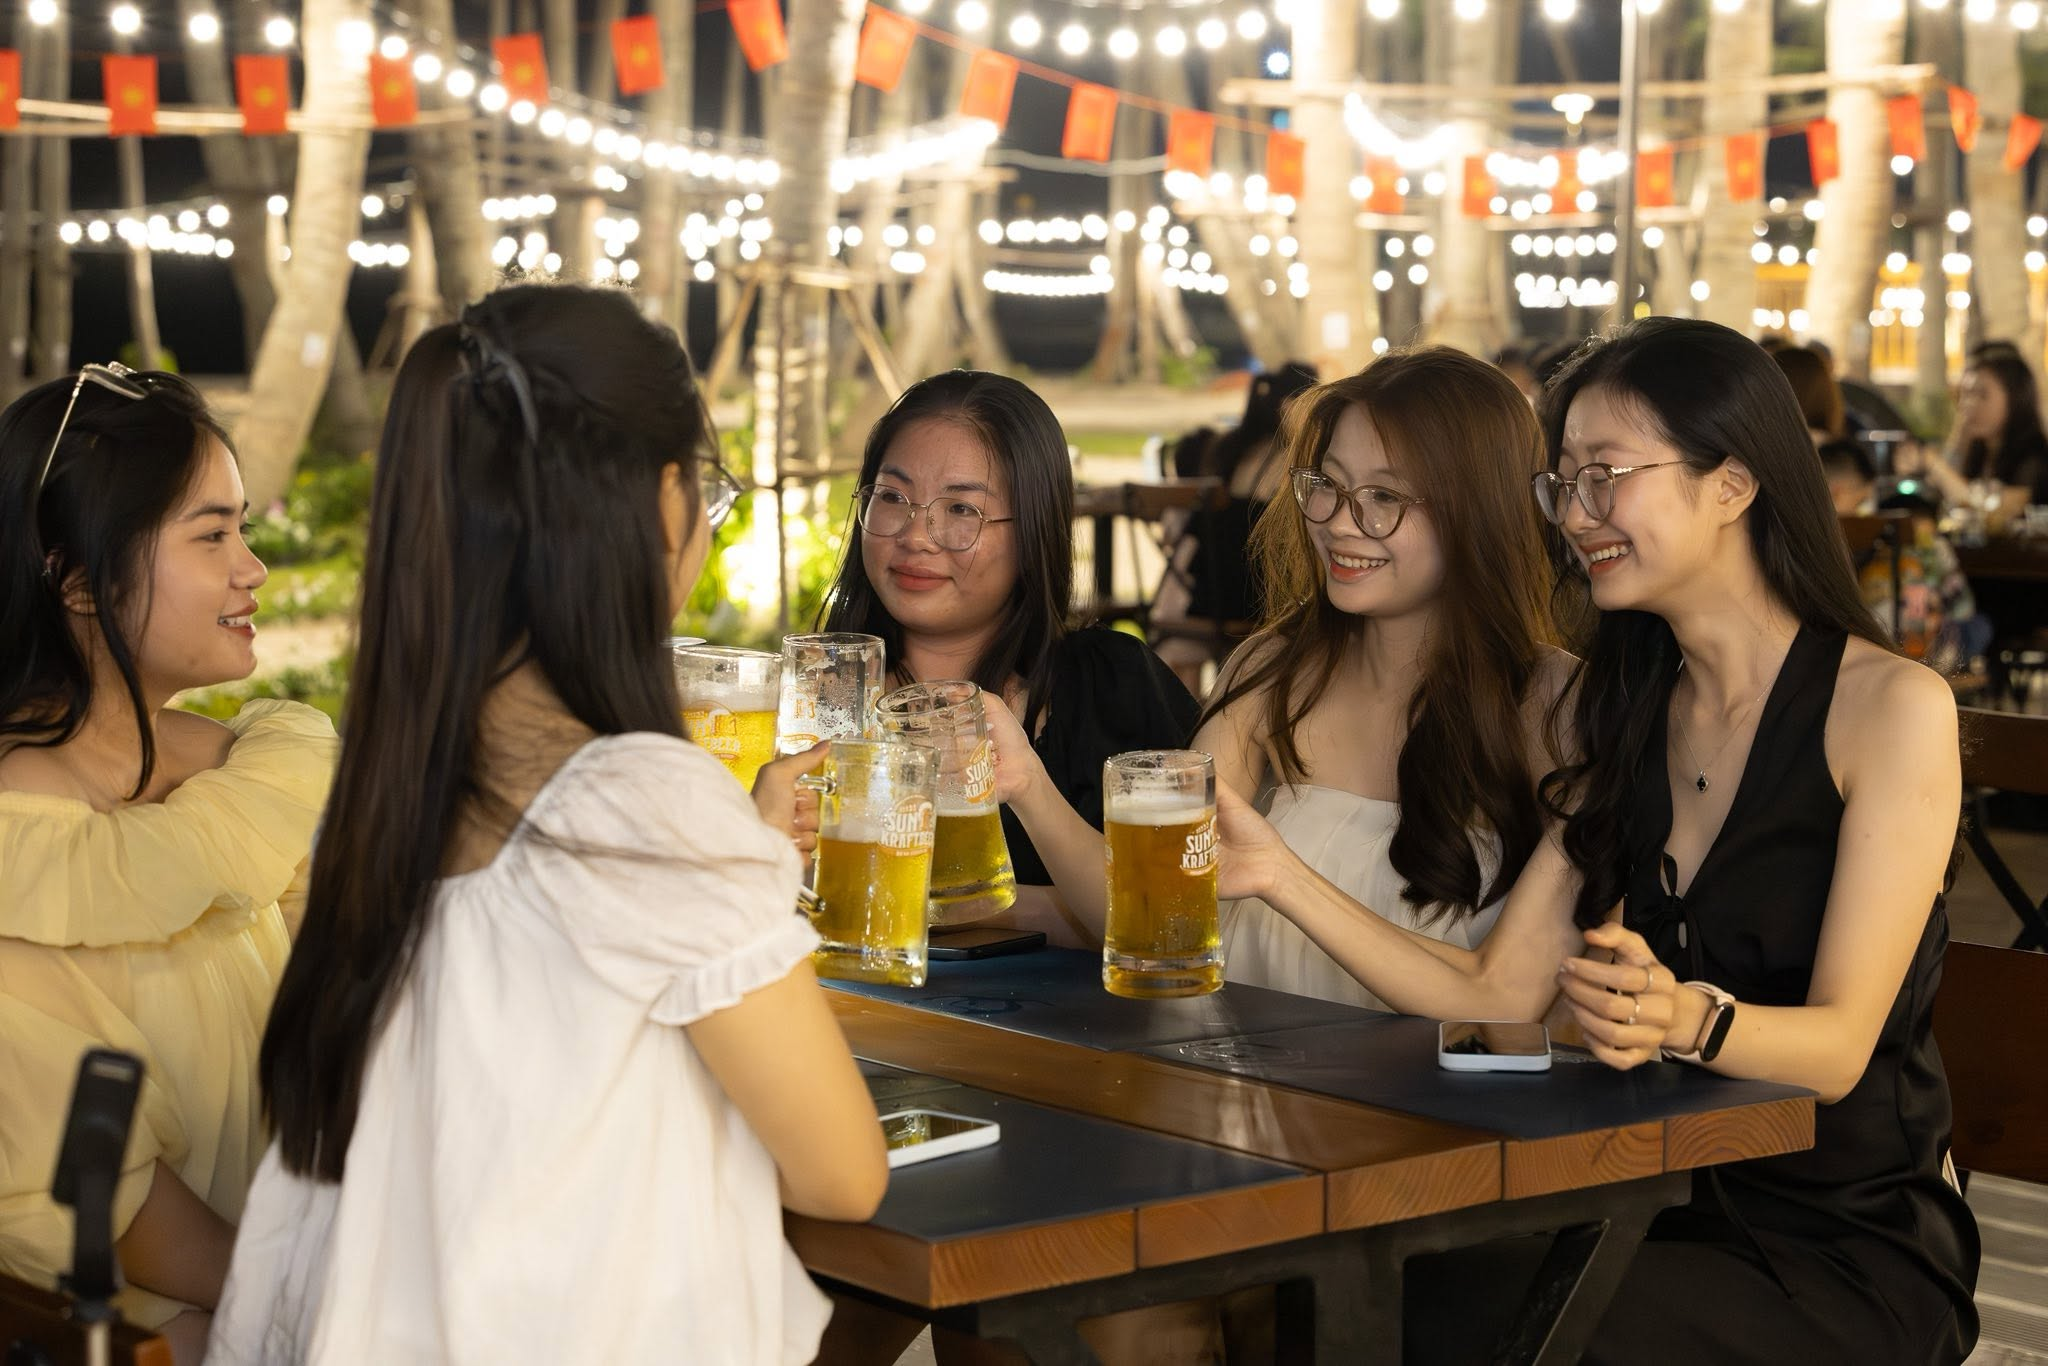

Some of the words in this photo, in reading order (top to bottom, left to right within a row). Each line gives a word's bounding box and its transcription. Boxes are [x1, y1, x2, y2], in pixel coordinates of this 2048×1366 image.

[966, 757, 989, 784] SUN
[887, 812, 918, 832] SUN
[1186, 830, 1211, 854] SUN
